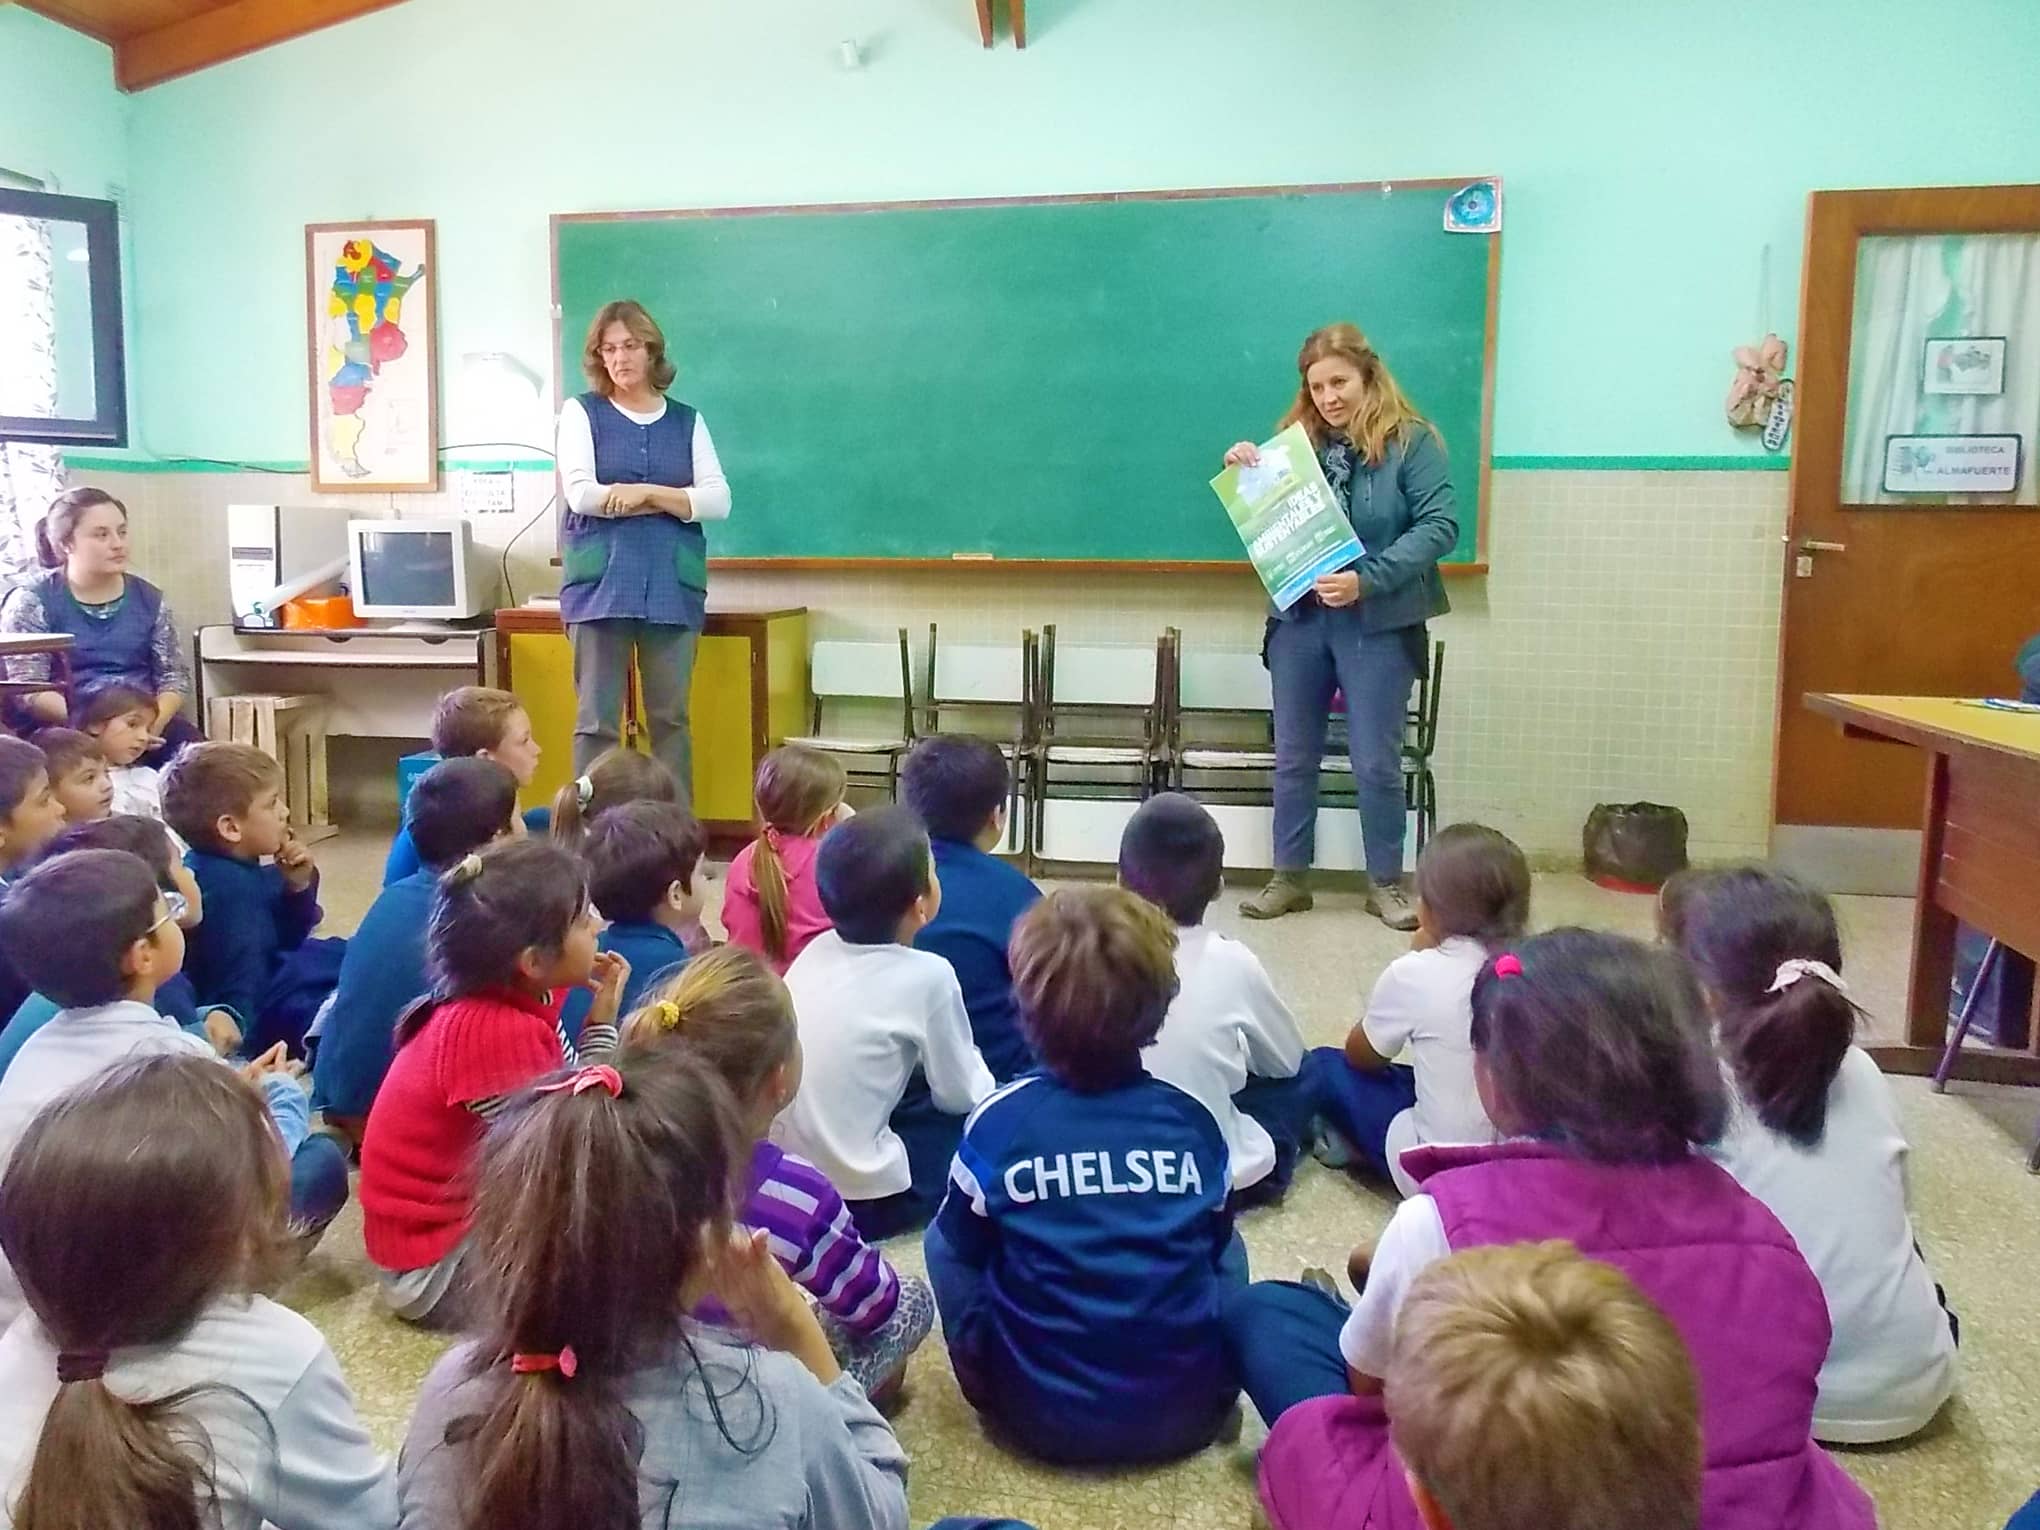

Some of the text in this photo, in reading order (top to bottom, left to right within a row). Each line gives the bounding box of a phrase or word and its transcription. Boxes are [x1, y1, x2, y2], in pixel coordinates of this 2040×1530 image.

[1945, 446, 2005, 455] BIBLIOTECA
[1936, 466, 2011, 476] ALMAFUERTE
[1286, 481, 1319, 509] IDEAS
[1003, 1150, 1203, 1203] CHELSEA
